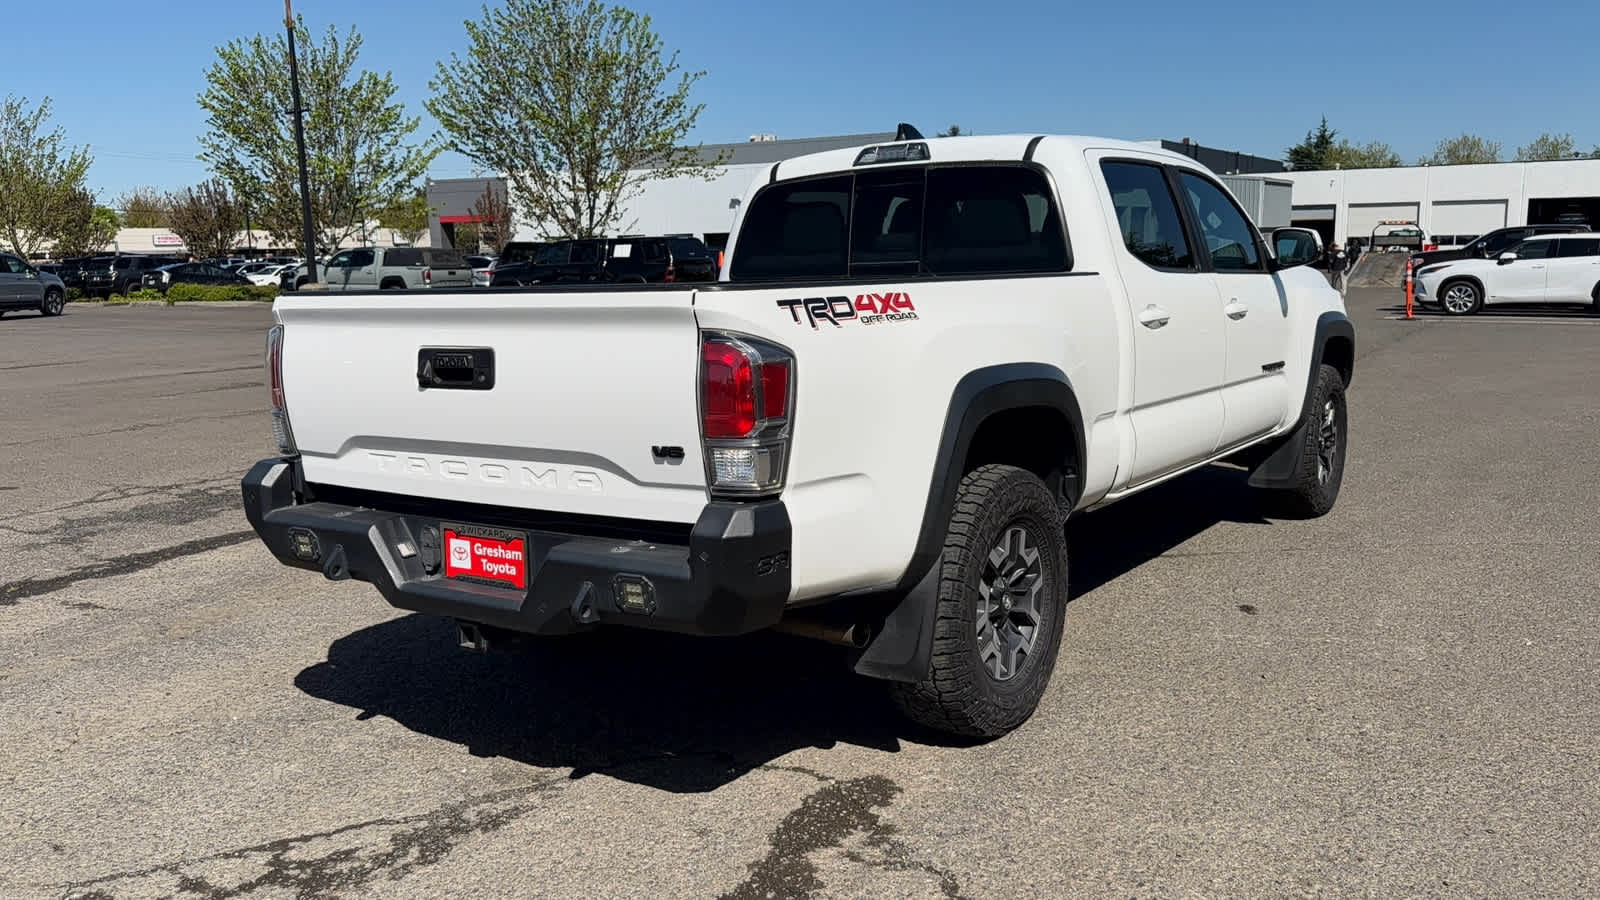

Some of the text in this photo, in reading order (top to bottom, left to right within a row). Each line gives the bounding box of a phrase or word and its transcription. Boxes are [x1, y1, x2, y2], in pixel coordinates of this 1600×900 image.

[776, 296, 857, 330] TRD
[860, 312, 918, 325] OFF ROAD
[651, 446, 685, 458] V6
[367, 452, 605, 495] TACOMA
[474, 543, 522, 560] Gresham
[481, 558, 516, 576] Toyota
